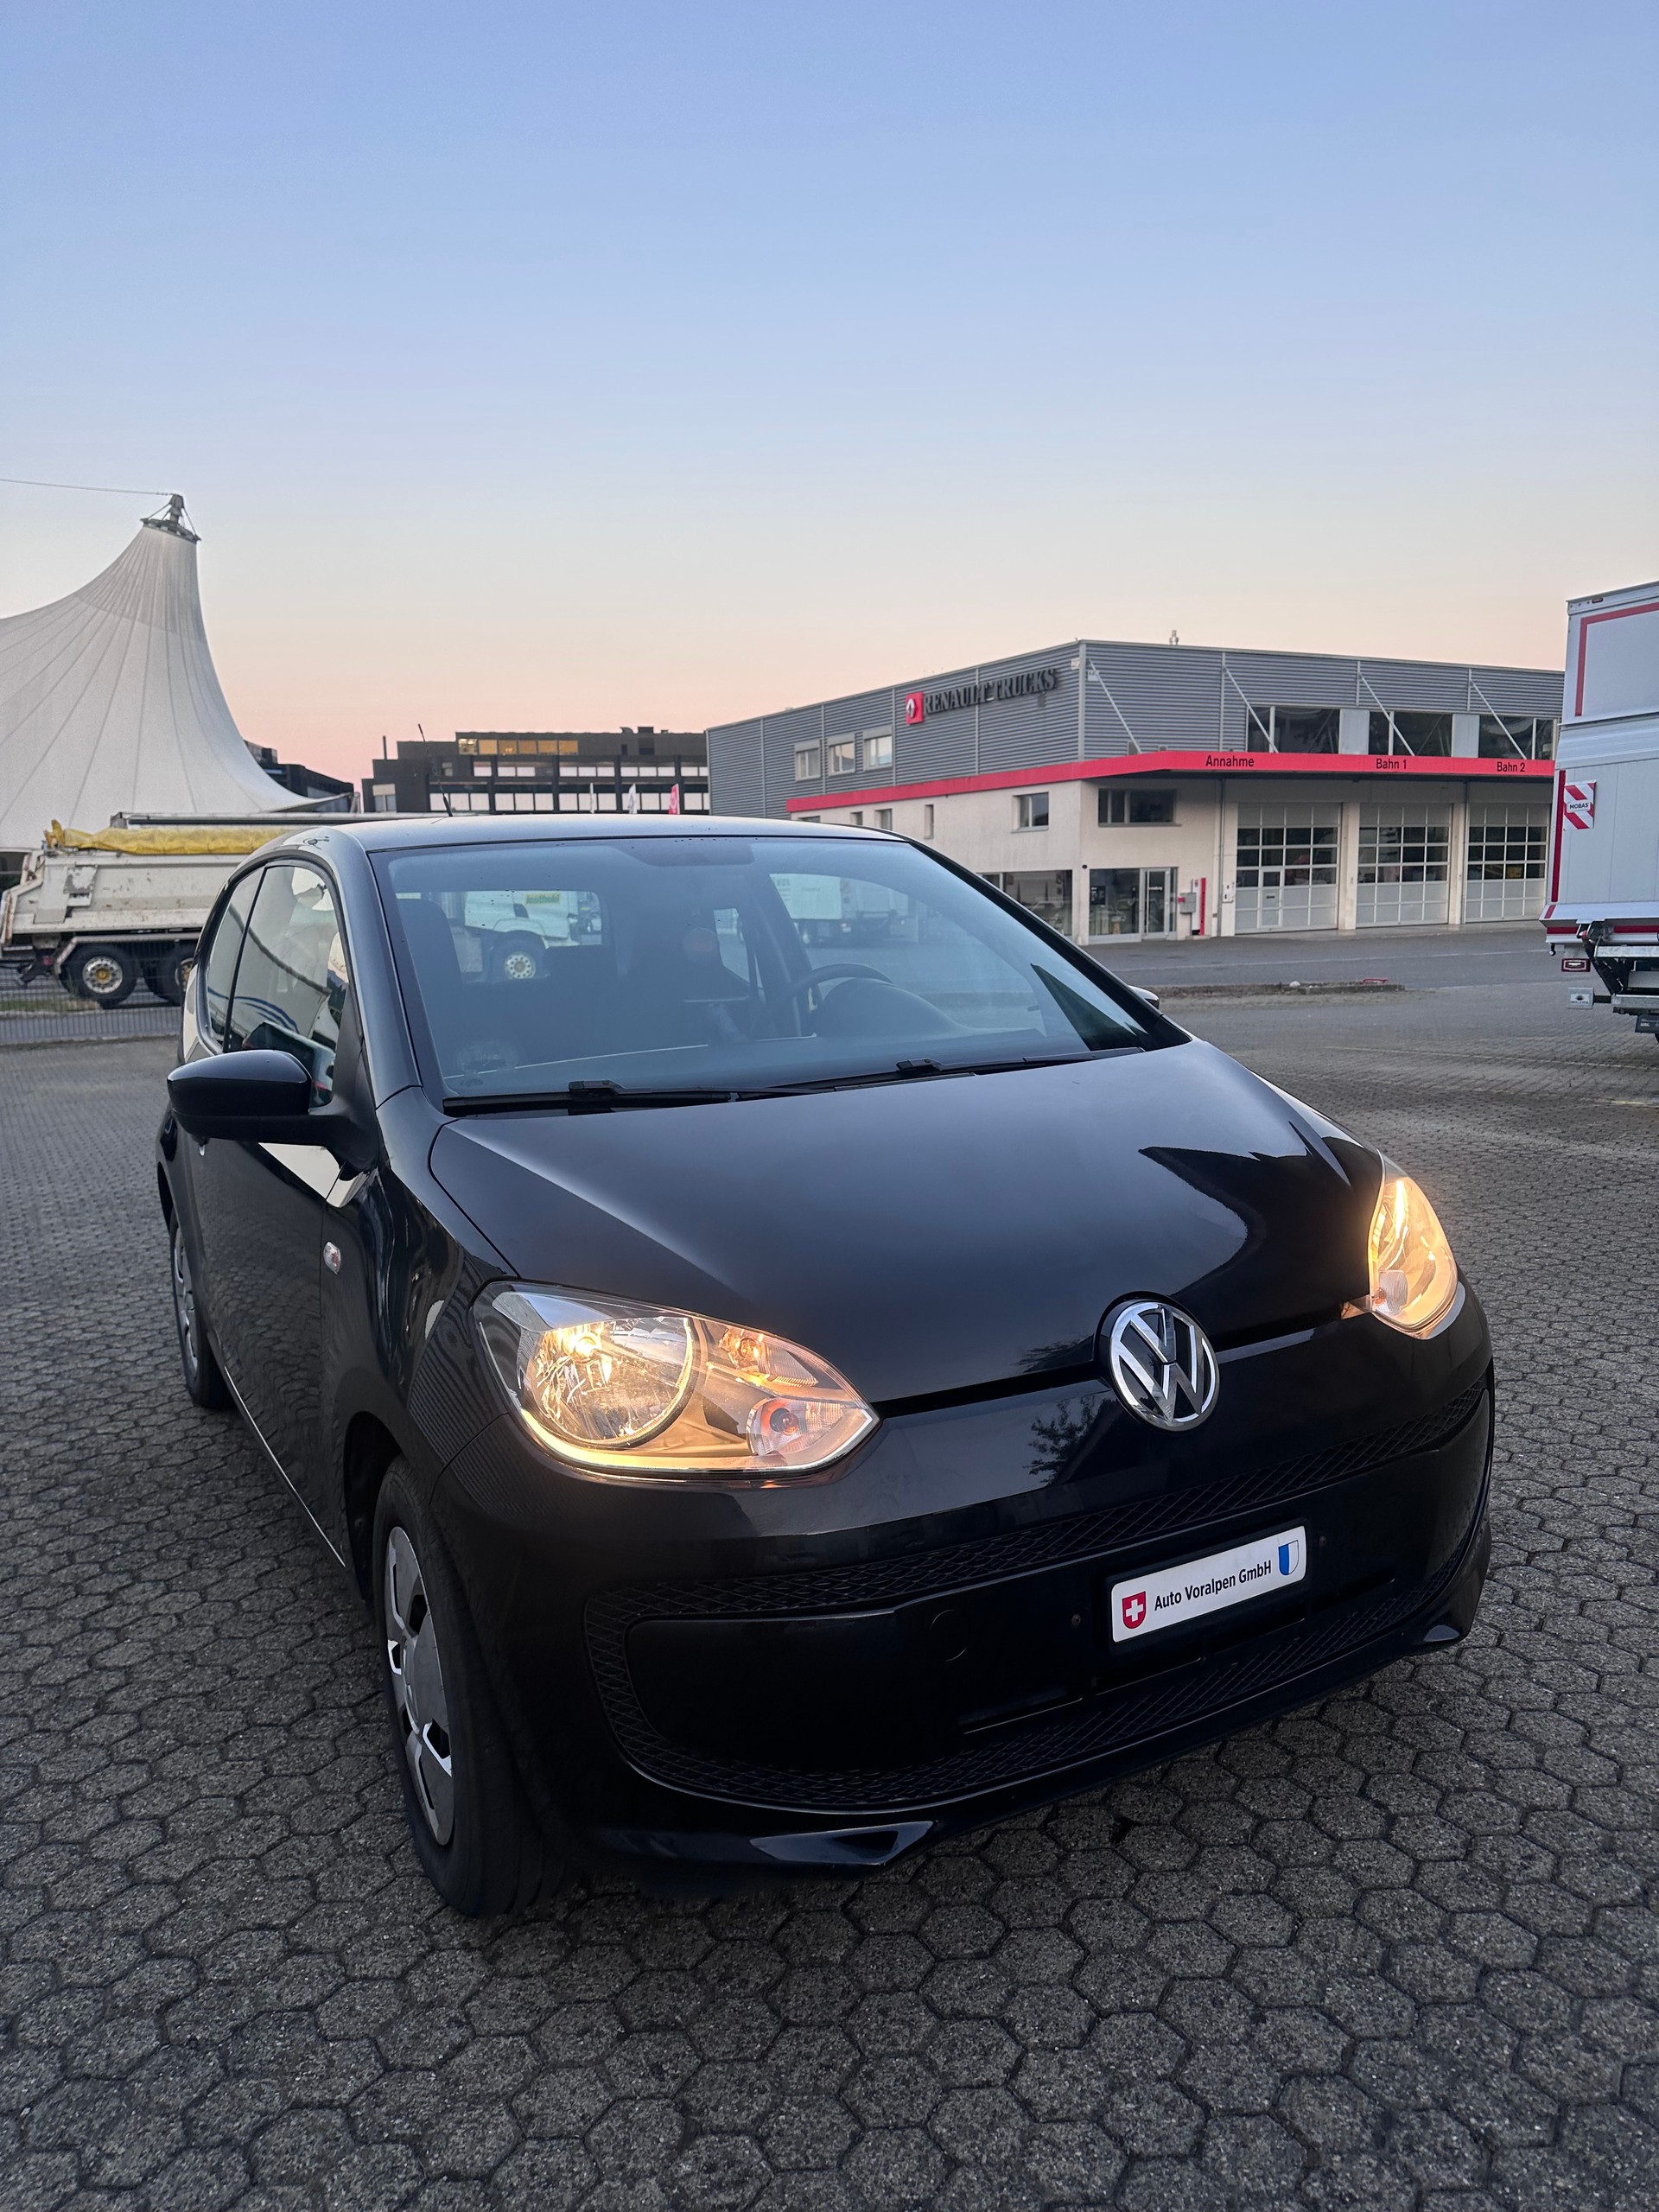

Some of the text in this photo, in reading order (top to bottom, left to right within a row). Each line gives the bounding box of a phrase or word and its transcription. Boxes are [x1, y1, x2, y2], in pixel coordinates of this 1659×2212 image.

[923, 668, 1057, 715] RENAULT TRUCKS
[1205, 754, 1255, 767] Annahme
[1376, 758, 1407, 769] Bahn 1
[1497, 761, 1526, 772] Bahn 2
[1113, 1303, 1217, 1427] VW
[1154, 1560, 1272, 1611] Auto Voralpen GmbH
